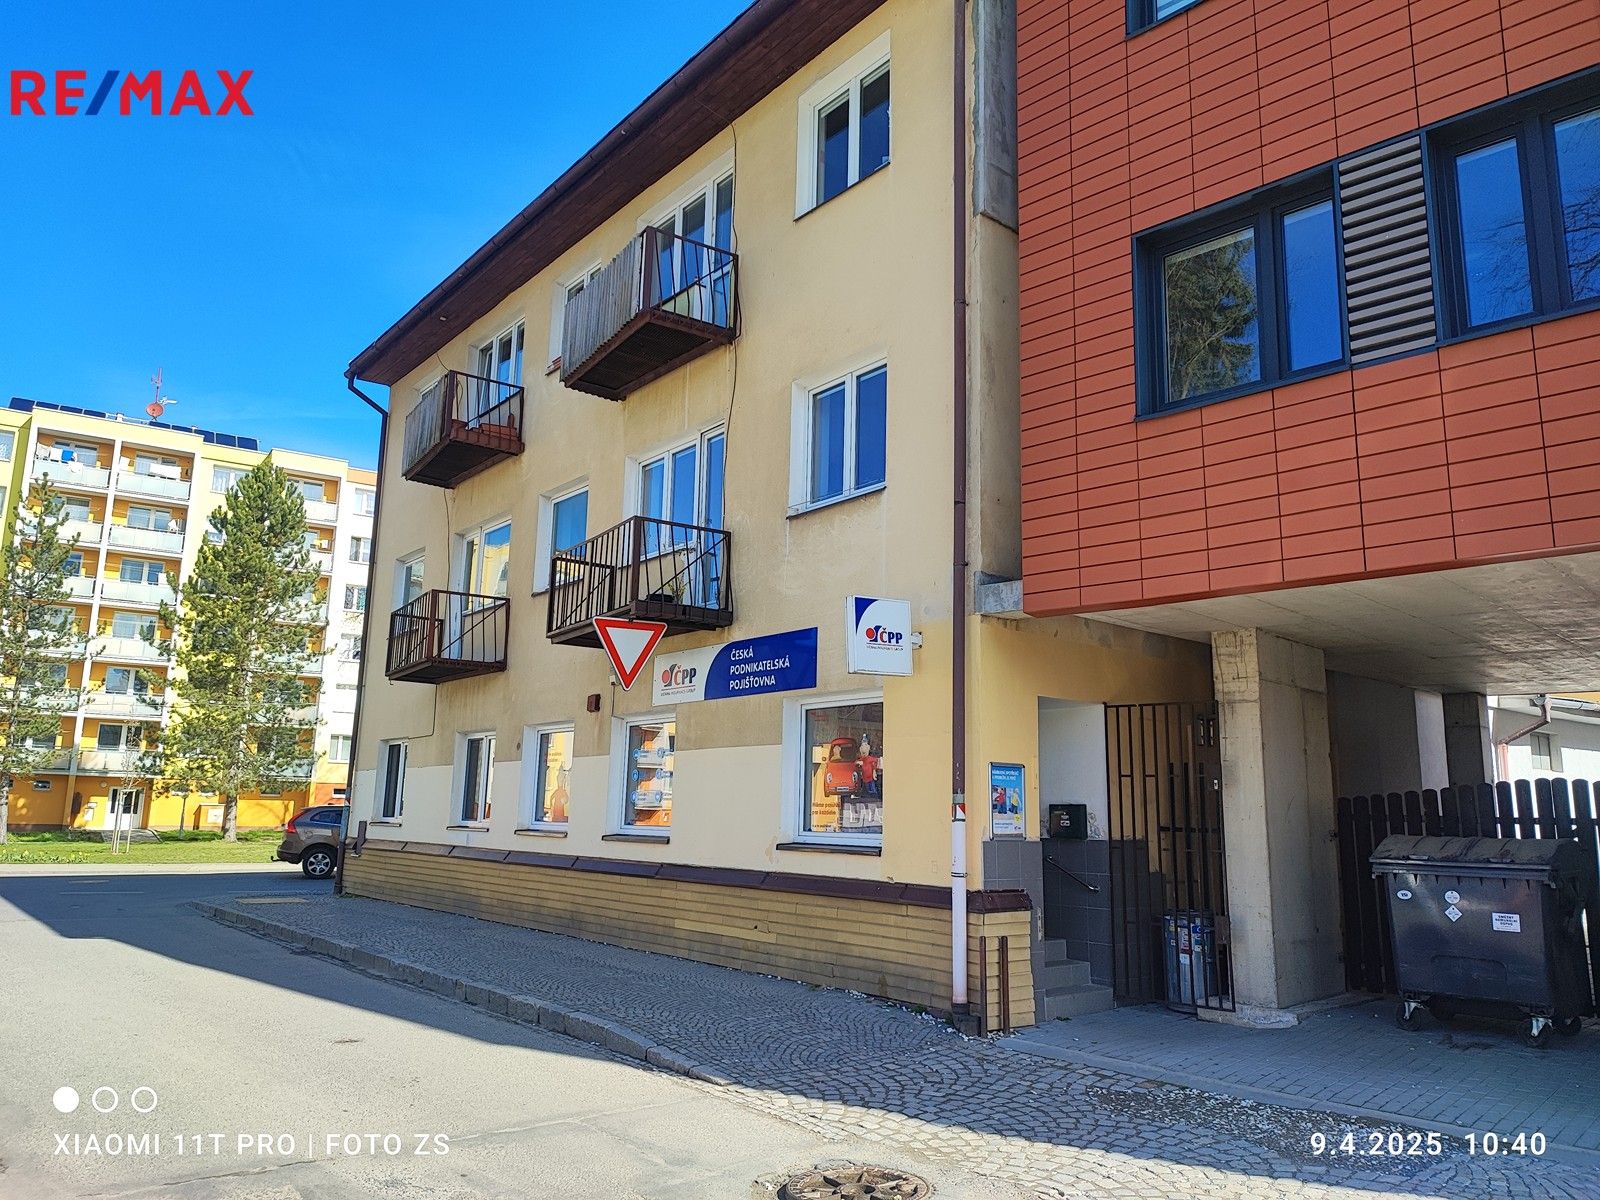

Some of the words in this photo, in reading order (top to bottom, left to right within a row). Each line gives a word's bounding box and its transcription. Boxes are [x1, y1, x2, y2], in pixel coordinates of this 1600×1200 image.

[879, 627, 903, 645] ČPP
[730, 646, 754, 661] ČESKÁ
[729, 655, 790, 676] PODNIKATELSKÁ
[673, 665, 697, 686] ČPP
[729, 675, 776, 691] POJIŠŤOVNA
